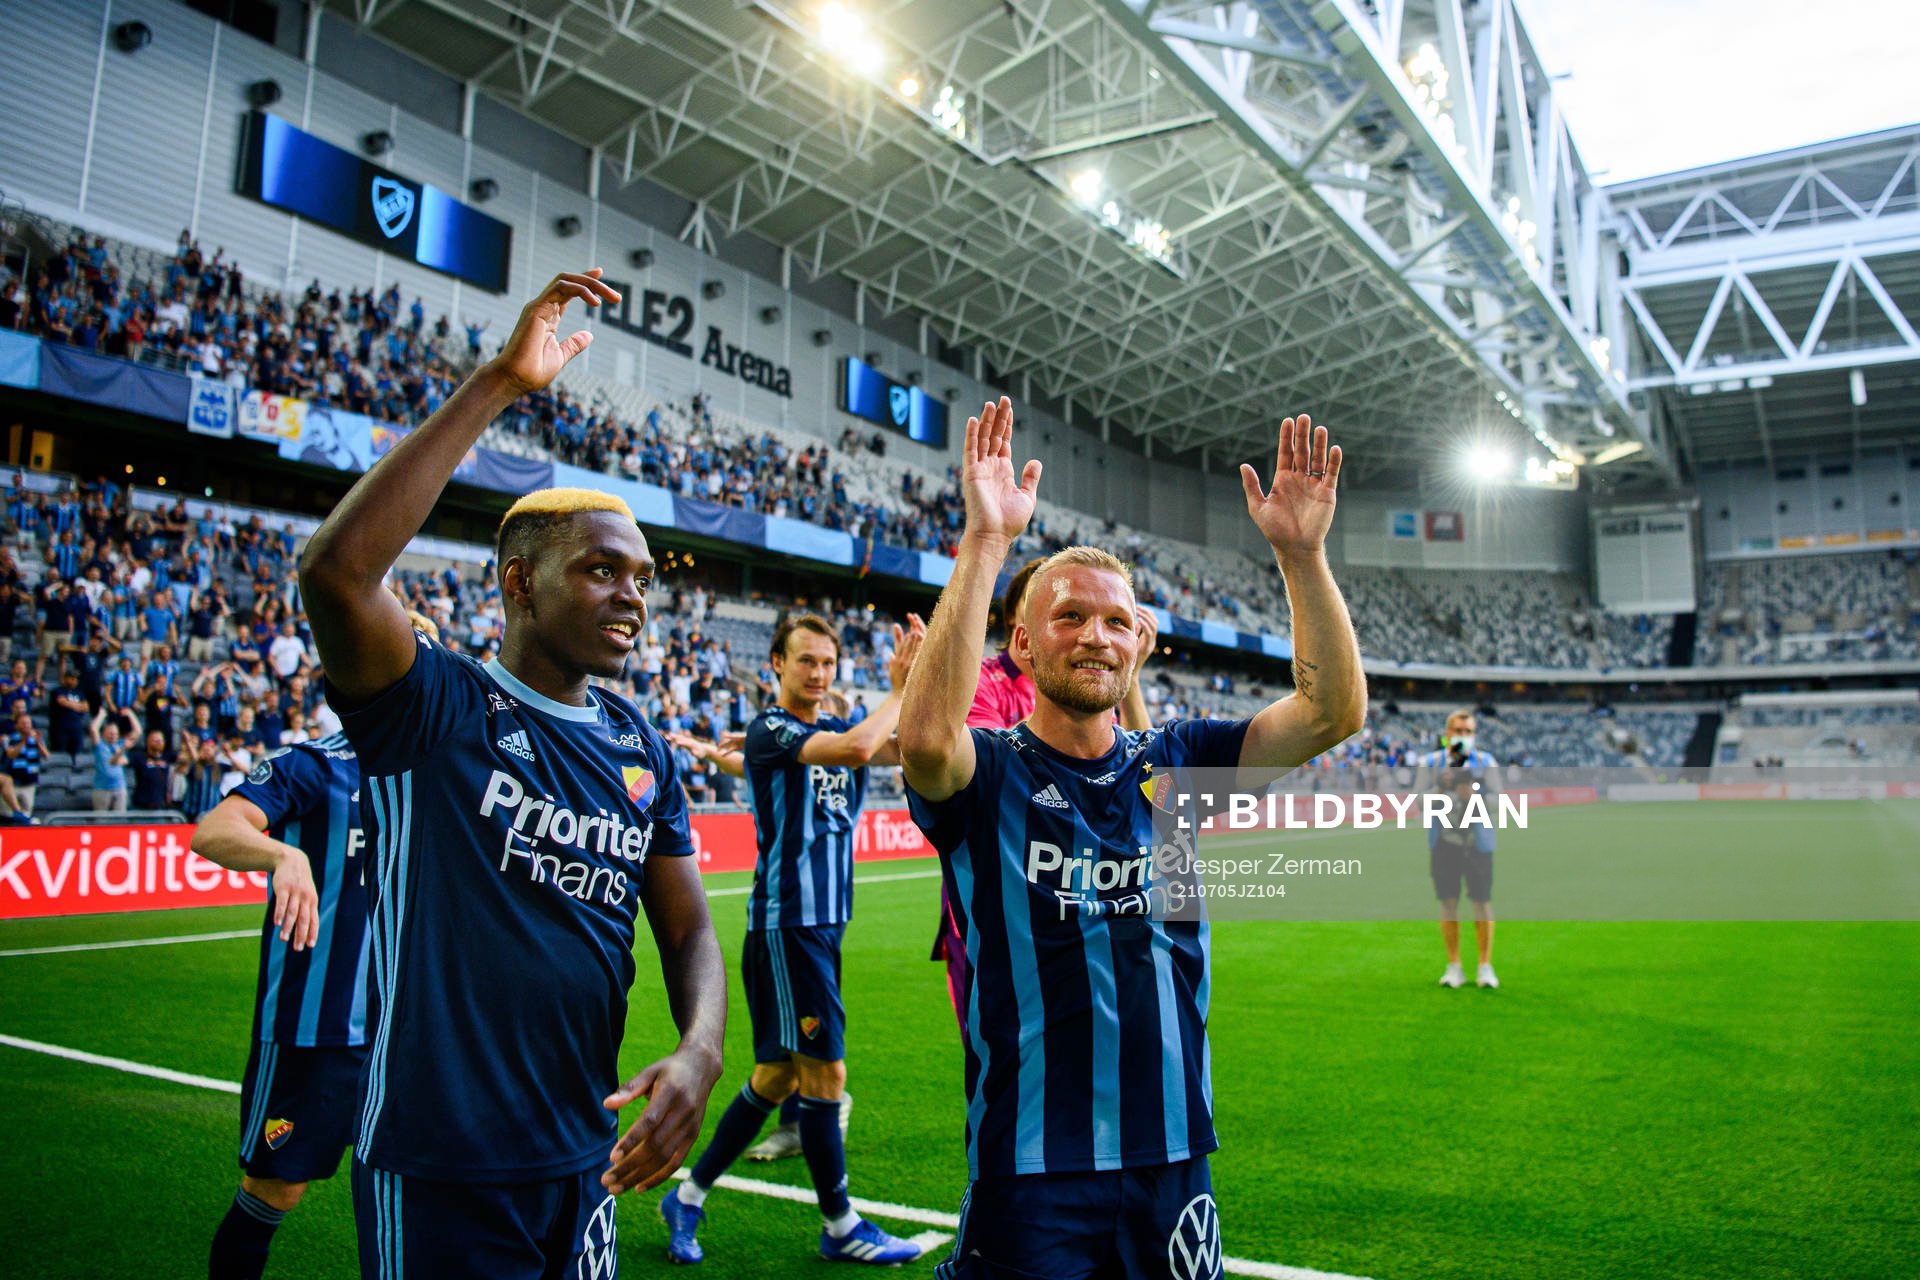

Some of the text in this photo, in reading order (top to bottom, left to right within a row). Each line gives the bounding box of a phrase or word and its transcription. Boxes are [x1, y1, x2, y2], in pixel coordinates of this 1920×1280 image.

[700, 325, 793, 399] Arena
[497, 740, 536, 762] adidas
[480, 770, 654, 864] Prioritet
[1032, 795, 1069, 809] adidas
[500, 827, 627, 905] Finans
[1027, 829, 1195, 891] Prioritet
